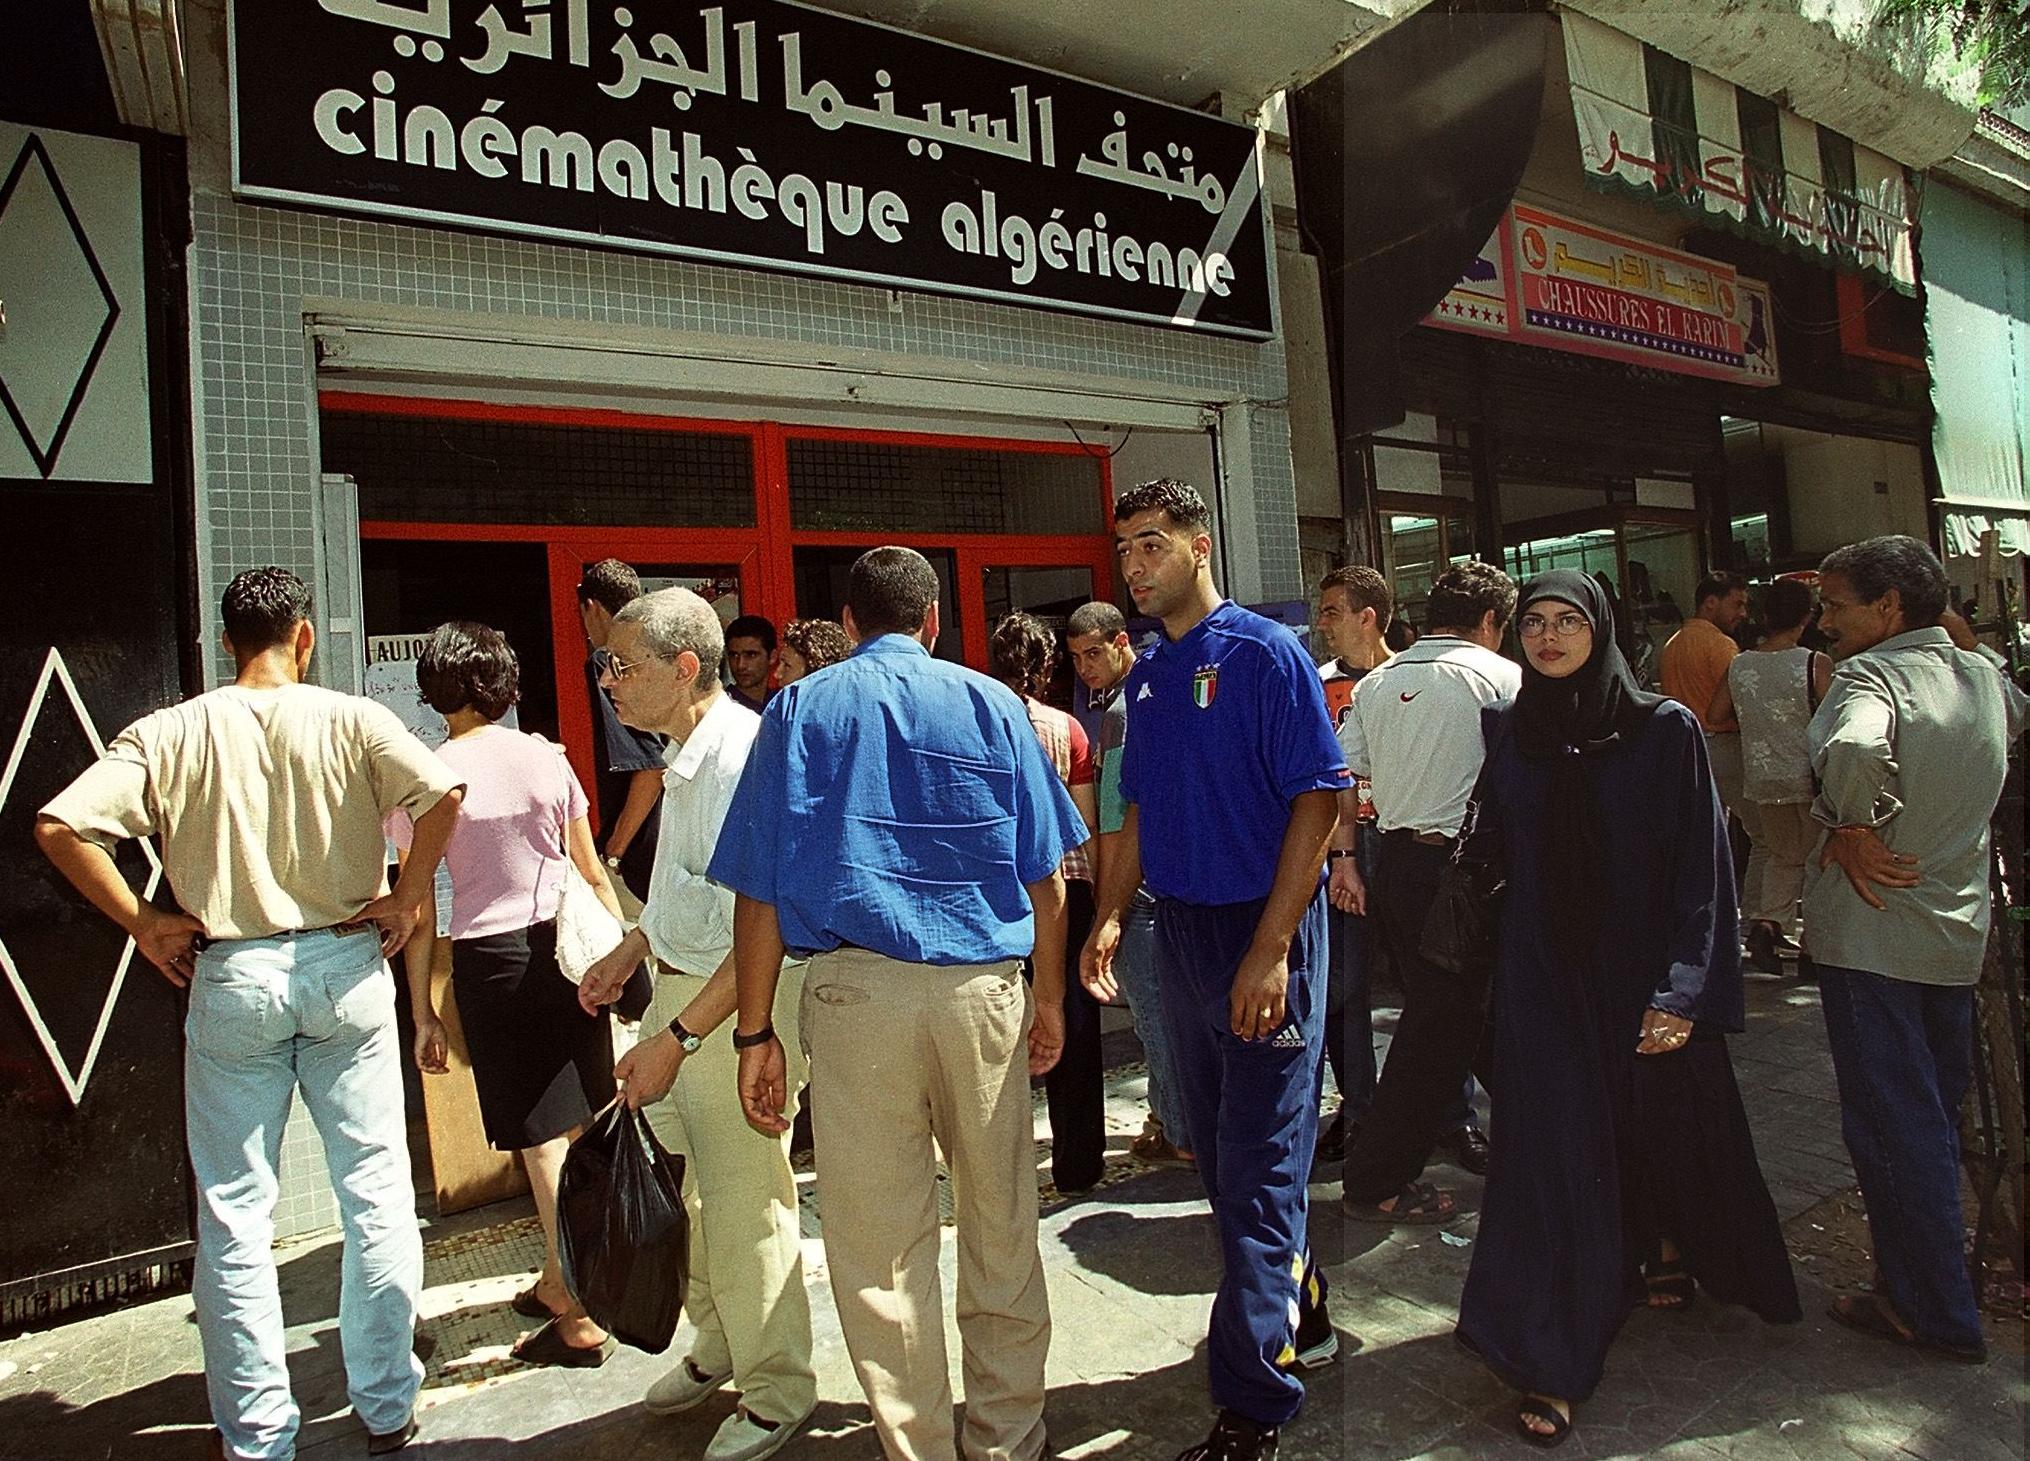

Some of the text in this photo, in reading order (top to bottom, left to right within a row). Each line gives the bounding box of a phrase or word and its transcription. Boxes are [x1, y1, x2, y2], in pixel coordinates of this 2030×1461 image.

[317, 0, 1225, 214] متحف السينما الجزائري
[313, 70, 1235, 297] cinémathèque algérienne
[1537, 279, 1731, 349] CHAUSSURES EL KARIM
[377, 639, 429, 662] AUJO
[1272, 1039, 1306, 1047] adidas
